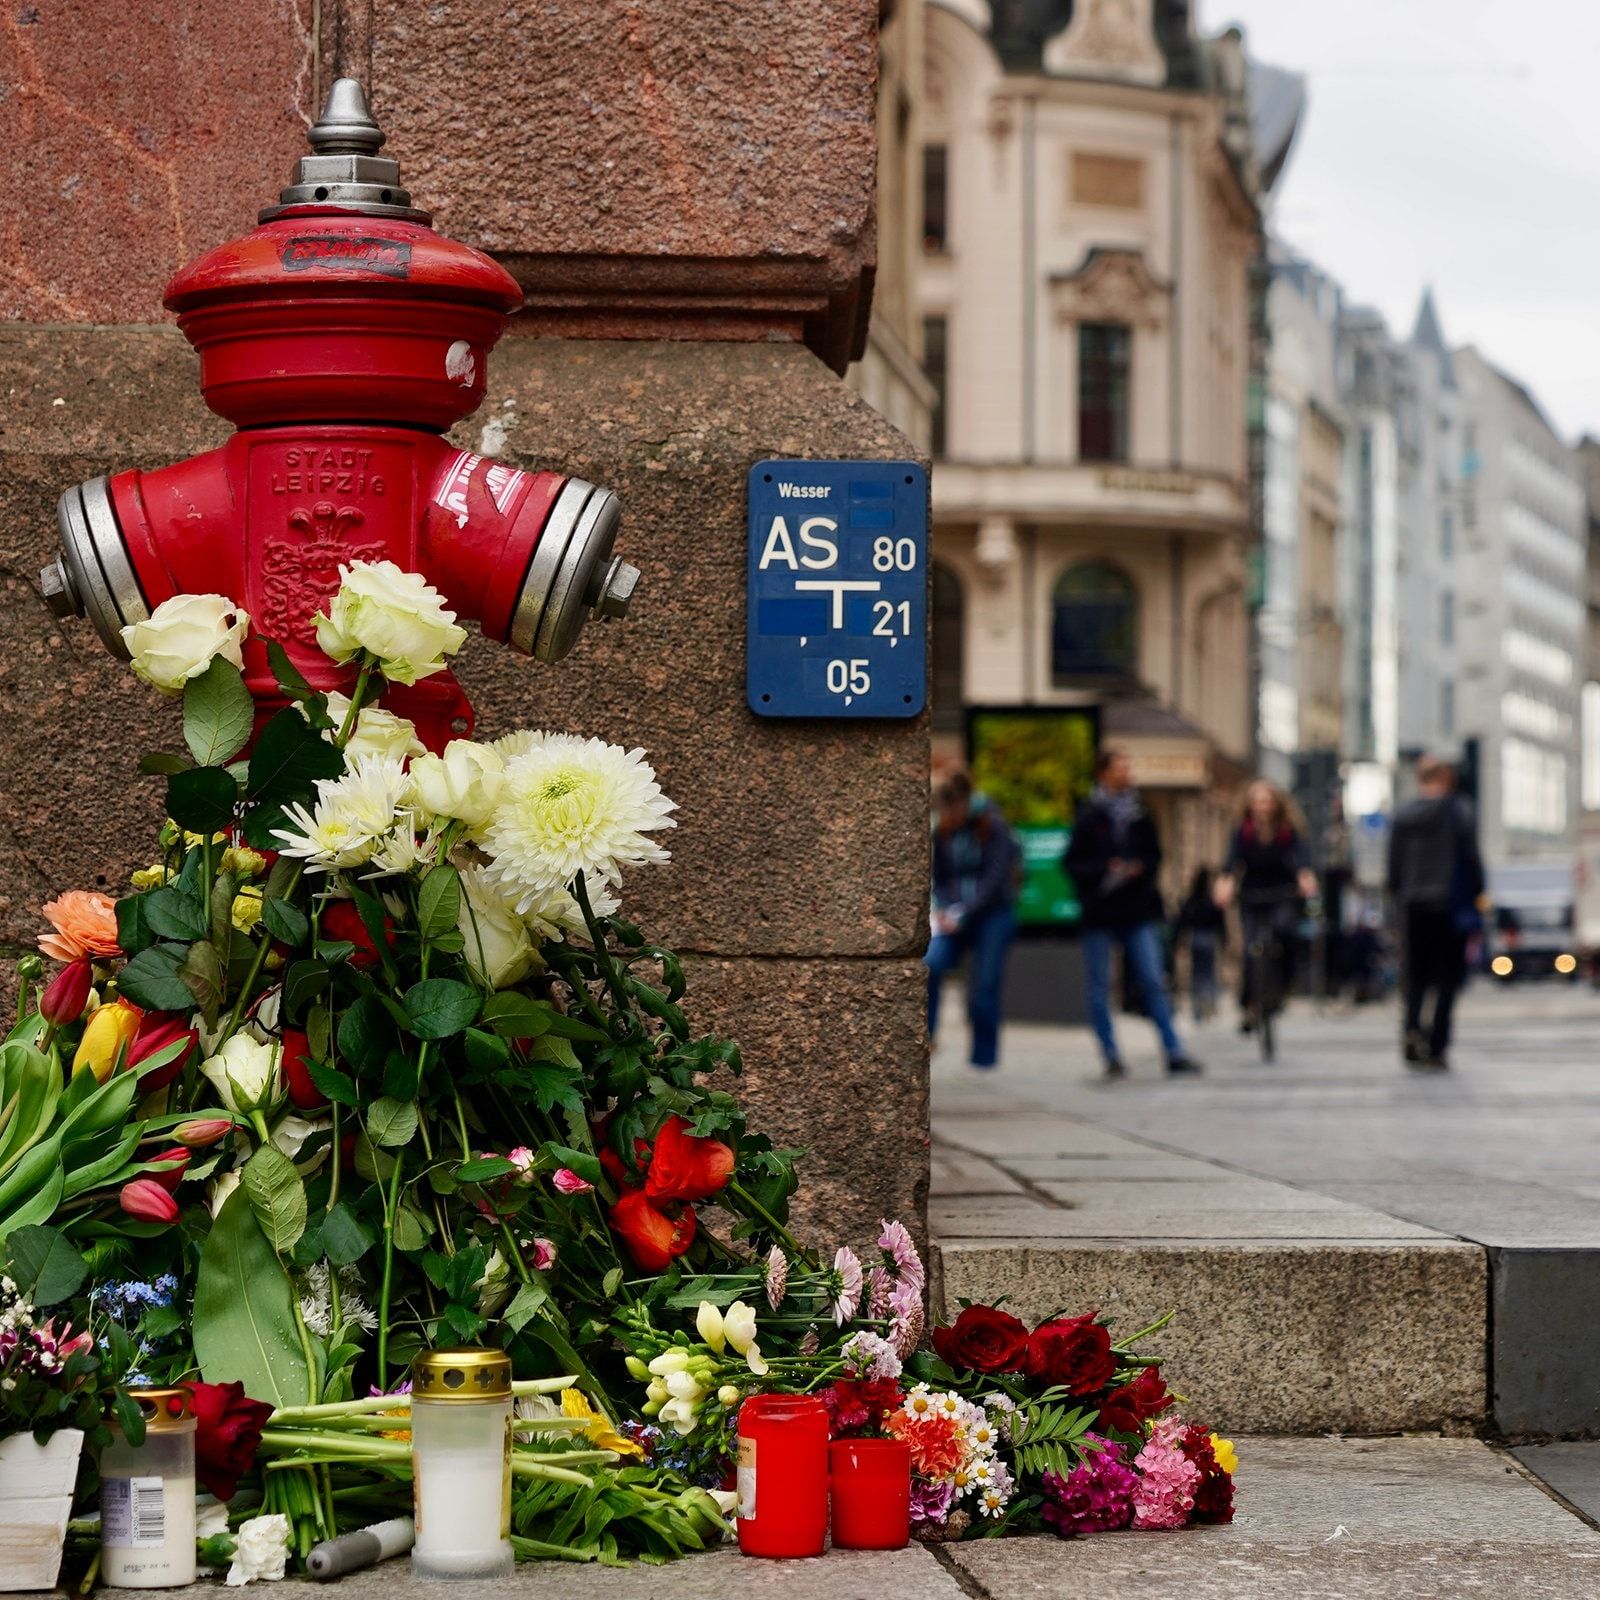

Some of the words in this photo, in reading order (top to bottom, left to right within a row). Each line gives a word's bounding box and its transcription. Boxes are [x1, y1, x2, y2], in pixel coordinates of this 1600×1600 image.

[286, 448, 374, 469] STADT
[778, 482, 831, 498] Wasser
[759, 516, 838, 571] AS
[872, 536, 917, 572] 80
